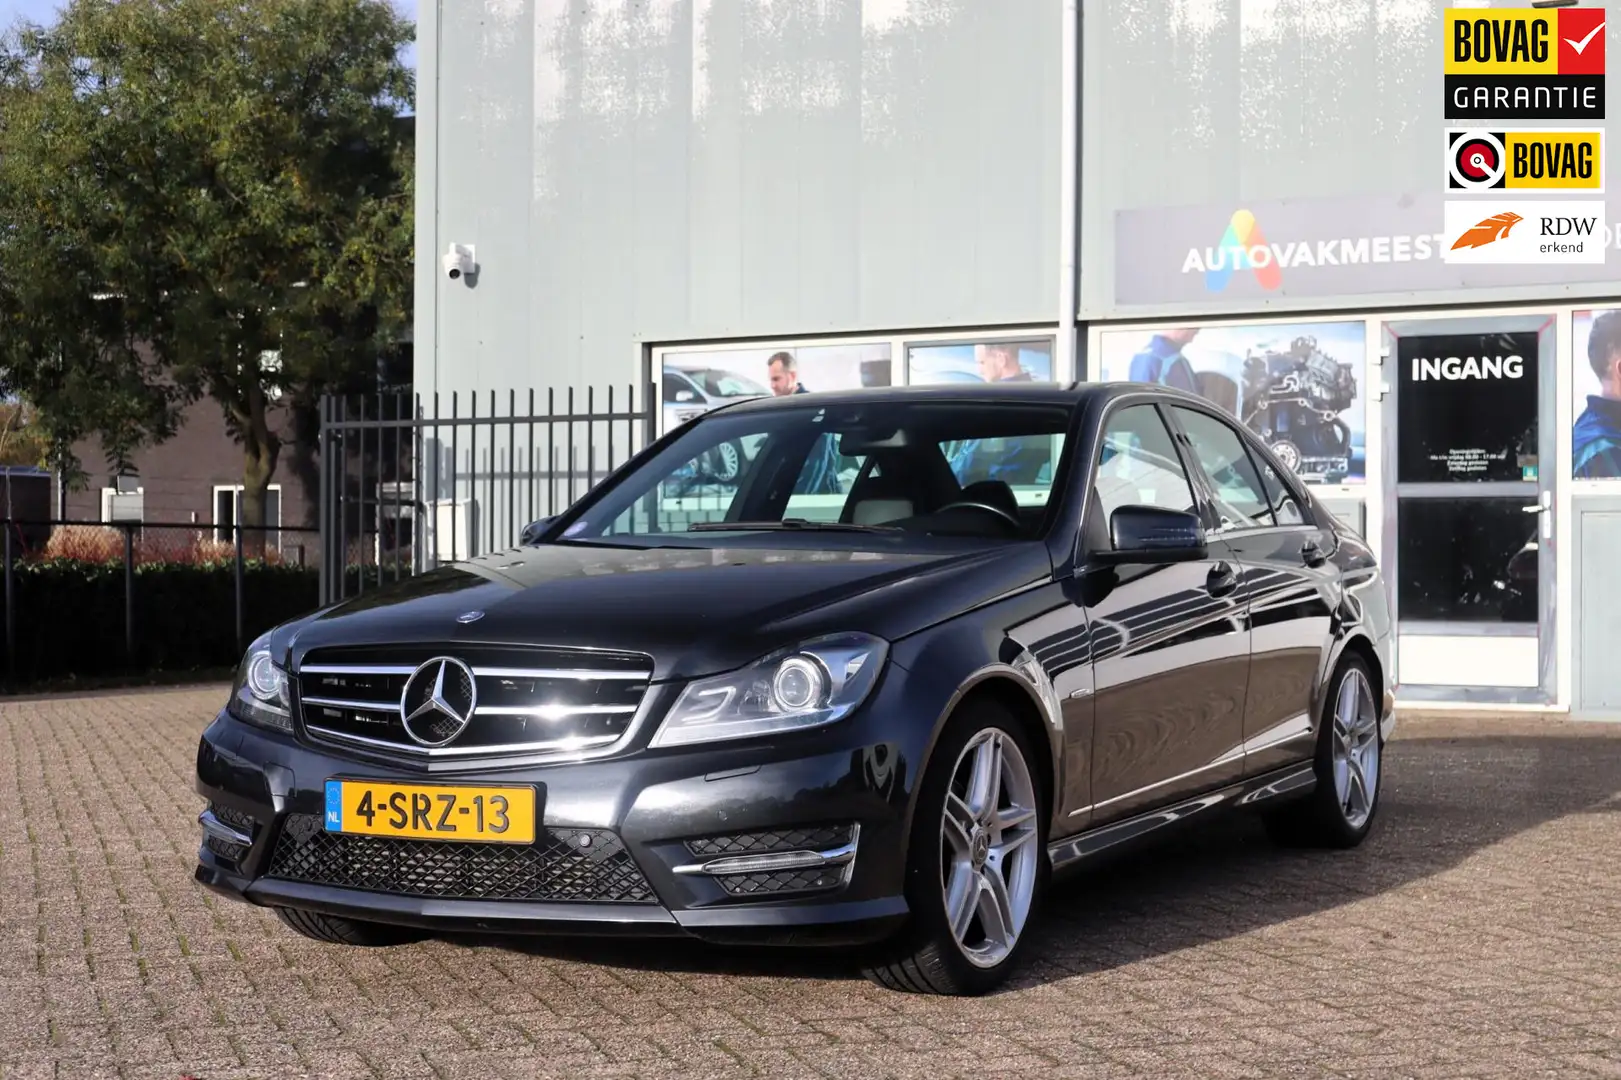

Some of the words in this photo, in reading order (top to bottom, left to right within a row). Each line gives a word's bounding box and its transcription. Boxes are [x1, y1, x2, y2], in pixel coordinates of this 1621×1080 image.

[1412, 355, 1523, 381] INGANG
[327, 811, 340, 823] NL
[356, 790, 510, 833] 4-SRZ-13
